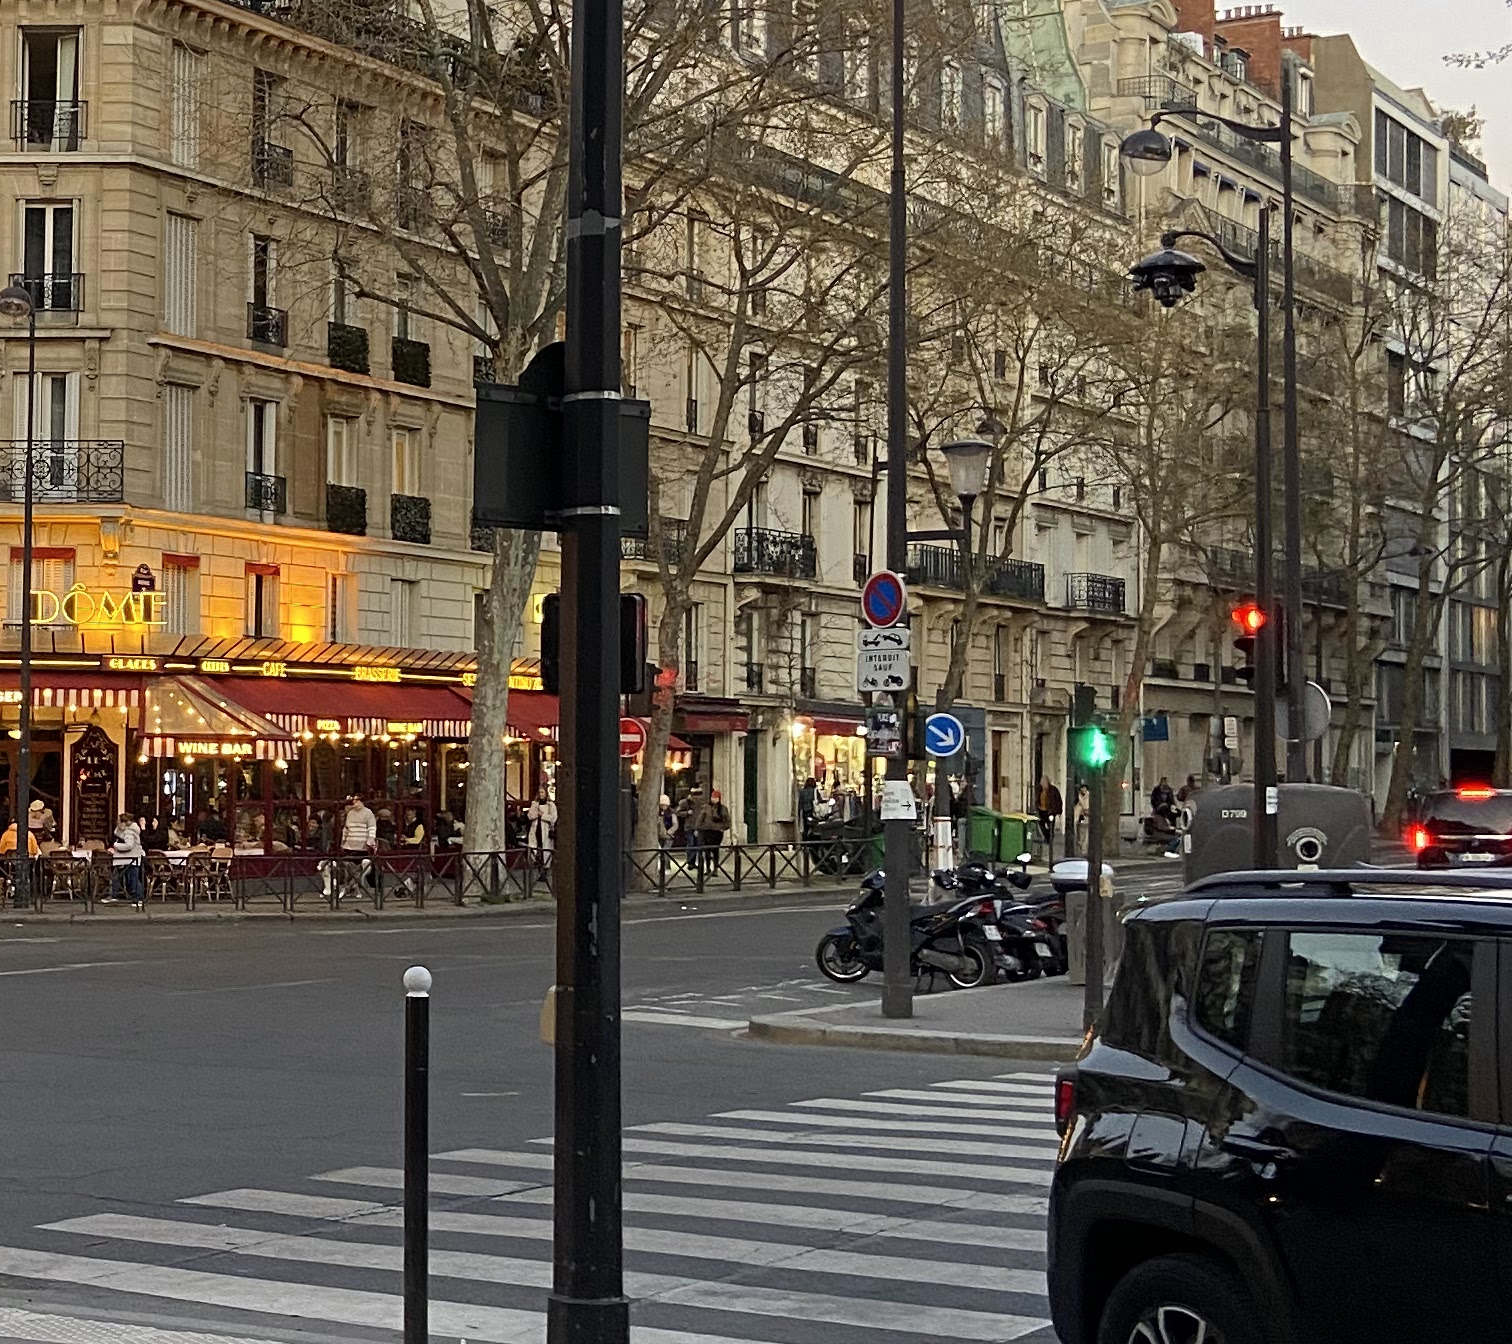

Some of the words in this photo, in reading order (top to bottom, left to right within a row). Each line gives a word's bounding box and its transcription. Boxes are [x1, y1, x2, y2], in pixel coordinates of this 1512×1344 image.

[29, 582, 168, 625] DÔME
[865, 654, 900, 663] INTERDIT
[873, 663, 893, 672] SAUF
[354, 666, 402, 683] BRASSERIE
[178, 742, 219, 754] WINE
[221, 743, 253, 755] BAR
